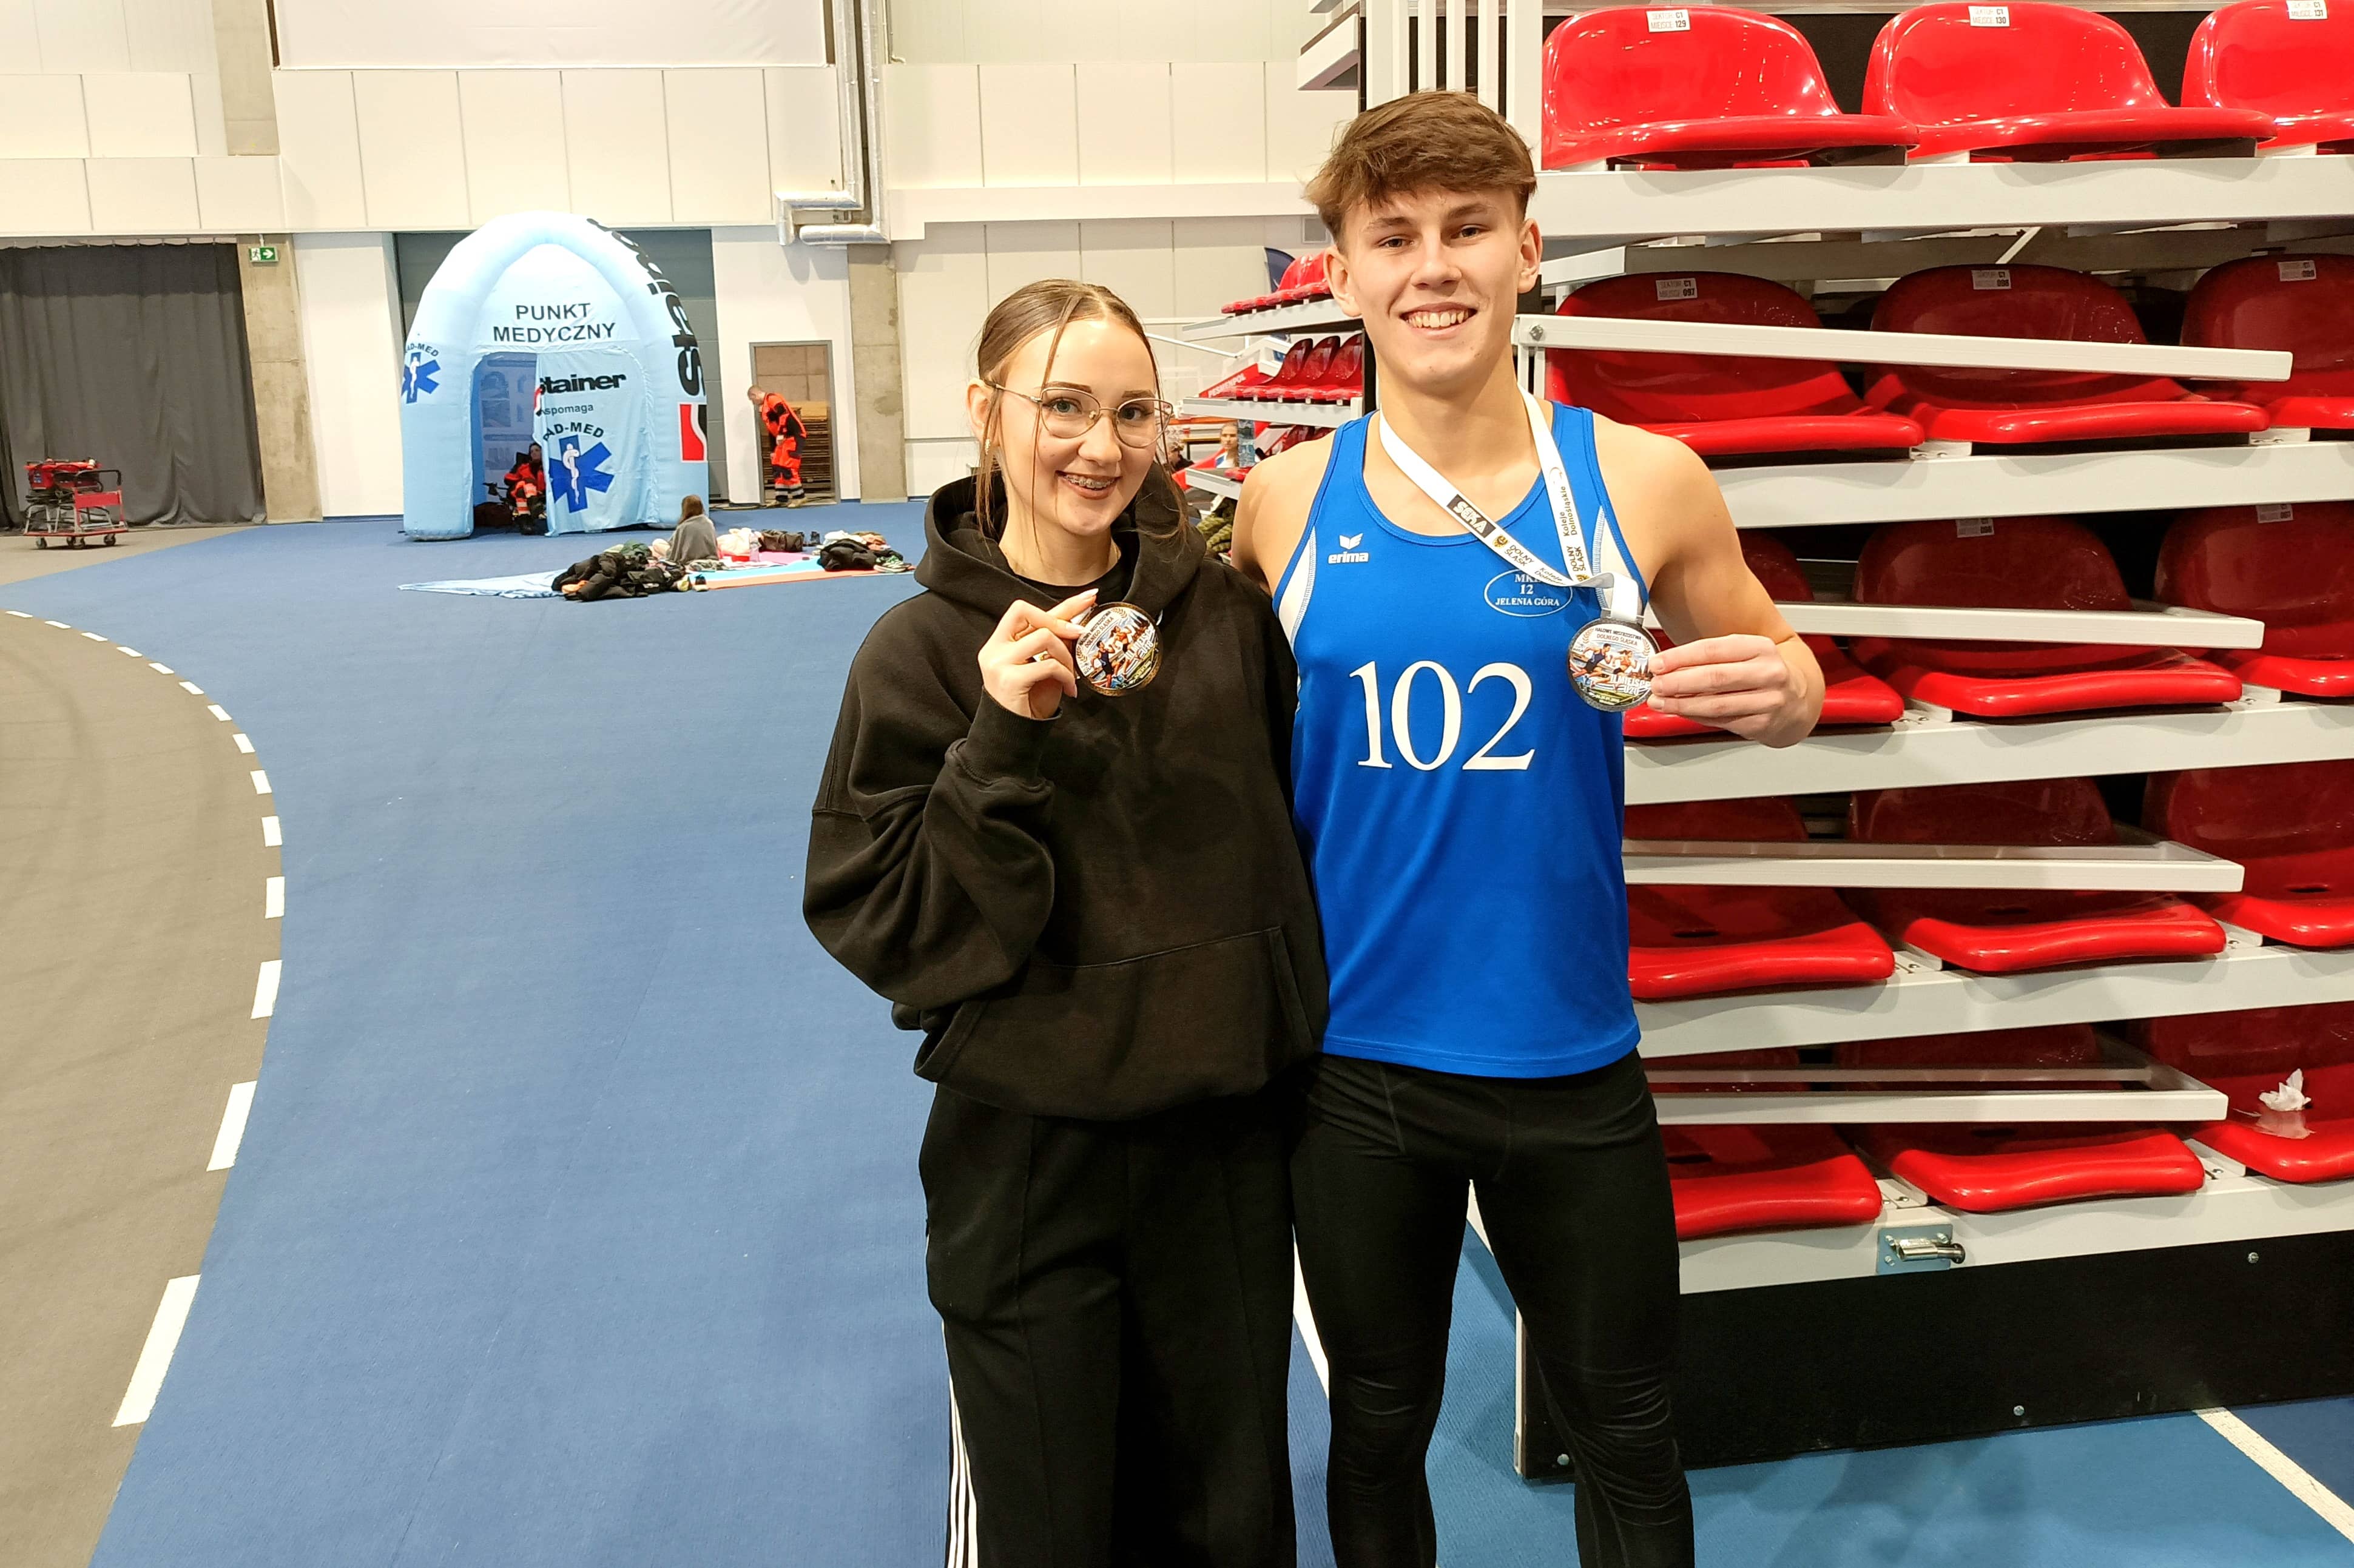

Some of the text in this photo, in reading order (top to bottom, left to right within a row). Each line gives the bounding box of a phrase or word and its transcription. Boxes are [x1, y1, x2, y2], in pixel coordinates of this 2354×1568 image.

[516, 303, 591, 320] PUNKT
[493, 322, 616, 343] MEDYCZNY
[1452, 500, 1488, 534] SEKA
[1560, 511, 1570, 537] Koleje
[1328, 551, 1369, 564] erima
[1509, 545, 1534, 564] DOLNY
[1567, 545, 1579, 571] DOLNY
[1519, 584, 1534, 595] 12
[1534, 596, 1560, 607] GÓRA
[1349, 660, 1536, 772] 102
